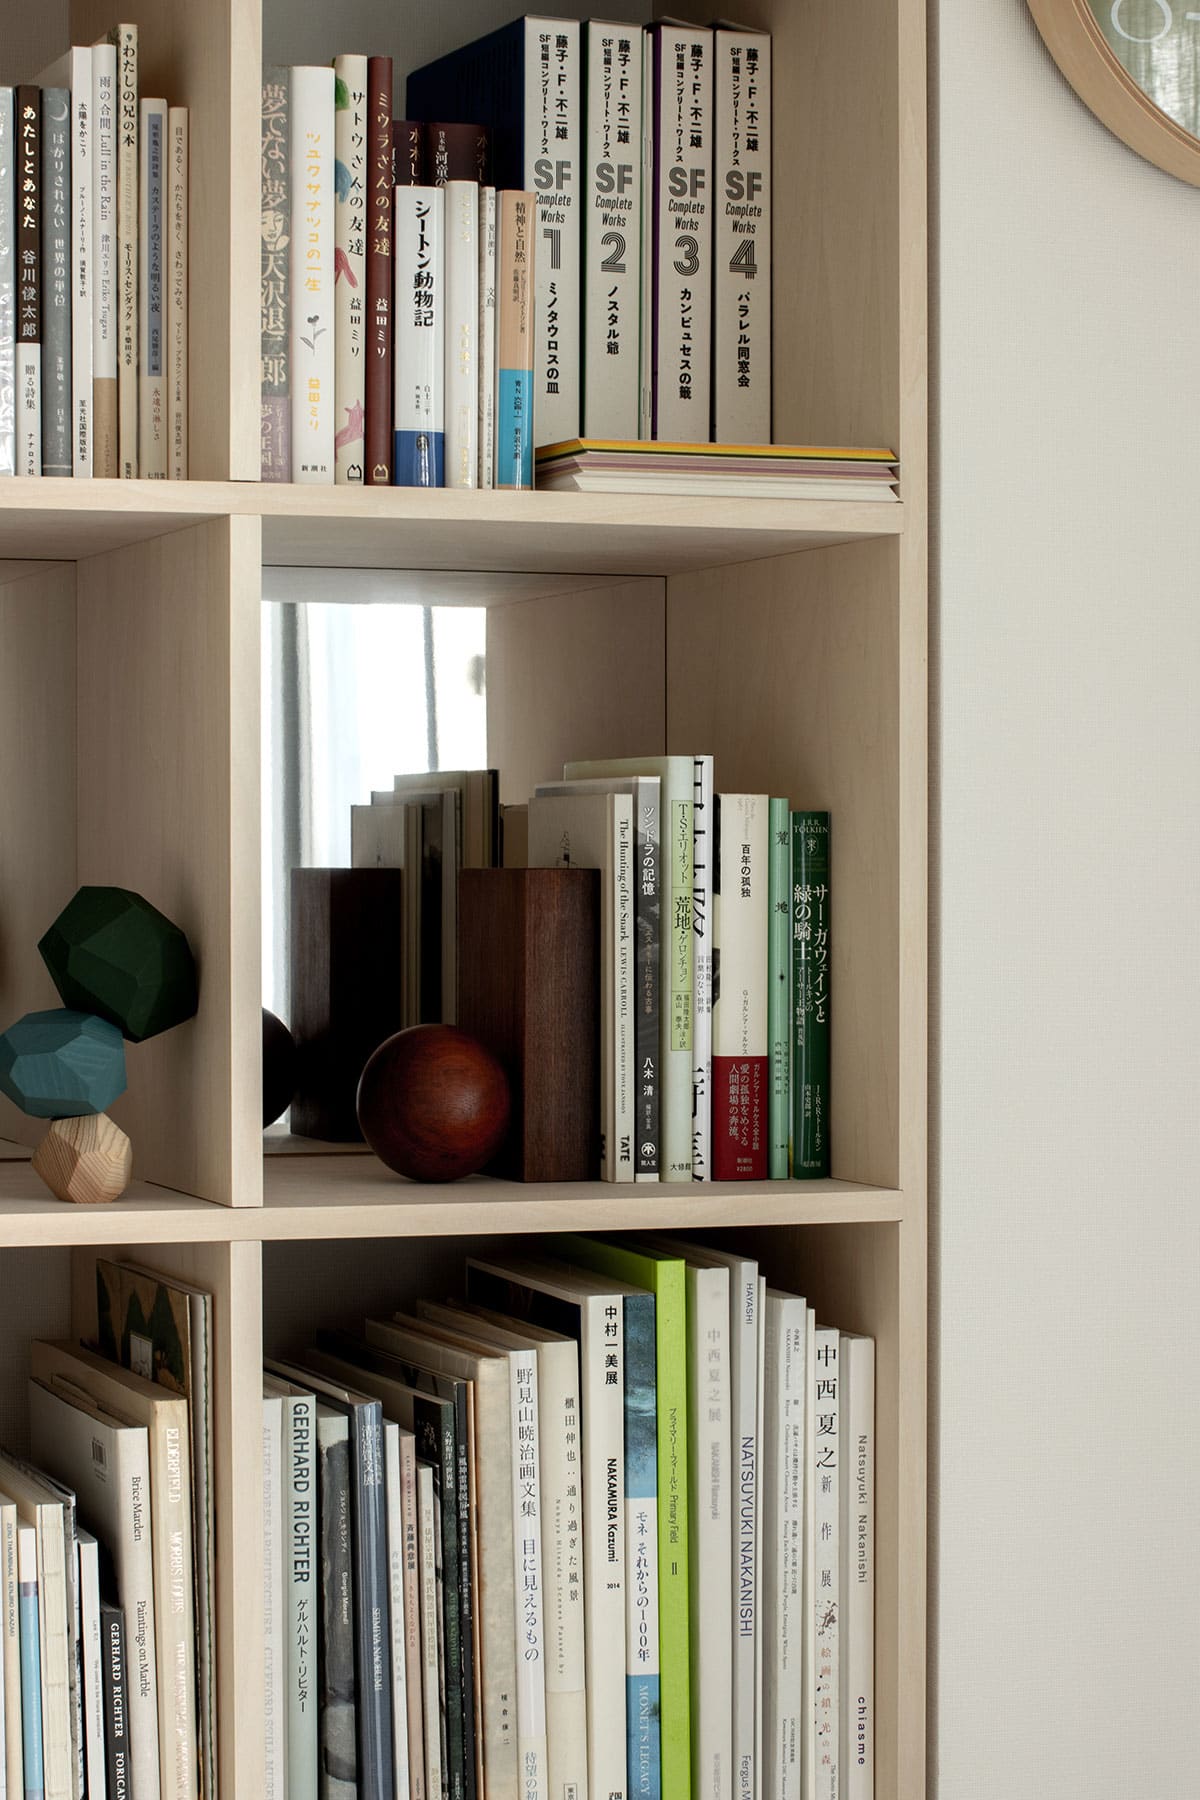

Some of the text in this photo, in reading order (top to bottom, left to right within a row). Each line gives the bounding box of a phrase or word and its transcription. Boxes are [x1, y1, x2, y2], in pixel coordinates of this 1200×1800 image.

[122, 45, 137, 147] わたしの兄の本
[539, 34, 551, 155] SF短編コンプリート・ワークス
[555, 35, 568, 140] 藤子・F・不二雄
[602, 38, 613, 158] SF短編コンプリート・ワークス
[617, 40, 631, 144] 藤子・F・不二雄
[674, 43, 687, 162] SF短編コンプリート・ワークス
[690, 44, 703, 149] 藤子・F・不二雄
[730, 47, 742, 166] SF短編コンプリート・ワークス
[746, 48, 759, 152] 藤子・F・不二雄
[78, 102, 87, 157] 太陽をかこう
[534, 158, 571, 190] SF
[535, 191, 571, 208] Complete
[595, 162, 633, 194] SF
[595, 194, 633, 212] Complete
[668, 166, 706, 198] SF
[725, 170, 763, 202] SF
[22, 105, 37, 338] あたしとあなた 谷川俊太郎
[100, 76, 111, 340] 雨の合間 Lull in the Rain 津川エリコ Eriko Tsugawa
[261, 84, 287, 386] 夢でない夢 天沢退二郎
[349, 91, 365, 358] サトウさんの友達 益田ミリ
[374, 92, 389, 359] ミウラさんの友達 益田ミリ
[514, 202, 525, 264] 精神と自然
[541, 209, 566, 224] Works
[602, 212, 627, 227] Works
[668, 198, 706, 216] Complete
[674, 216, 700, 231] Works
[725, 201, 763, 219] Complete
[732, 219, 757, 234] Works
[54, 239, 66, 307] 世界の単位
[151, 186, 160, 313] カステーラのような明るい夜
[413, 200, 434, 327] シートン動物記
[543, 228, 561, 270] 1
[600, 231, 627, 274] 2
[673, 234, 700, 277] 3
[729, 239, 758, 280] 4
[124, 243, 133, 321] モーリス・センダック
[306, 132, 321, 431] ツユクサナツコの一生 益田ミリ
[487, 287, 496, 307] 文鳥
[546, 282, 559, 394] ミノタウロスの皿
[607, 286, 619, 355] ノスタル爺
[679, 288, 692, 400] カンビュセスの籤
[737, 291, 750, 388] パラレル同窓会
[25, 364, 36, 410] 贈る詩集
[424, 385, 432, 416] 白土三平
[27, 433, 36, 476] ナナロク社
[301, 464, 327, 472] 新潮社
[619, 819, 629, 838] The
[641, 807, 655, 896] ツンドラの記憶
[677, 803, 690, 884] T・S・エリオット
[617, 841, 629, 882] Hunting
[619, 883, 629, 893] of
[740, 843, 751, 898] 百年の孤独
[619, 893, 629, 911] the
[619, 912, 629, 941] Snark
[793, 883, 812, 961] 緑の騎士
[674, 896, 691, 983] 荒地・ゲロンチョン
[813, 883, 829, 1023] サー・ガウェインと
[696, 956, 704, 1015] 言葉のない世界
[805, 966, 814, 1012] トールキンの
[729, 1063, 740, 1141] 人間劇場の奔流。
[740, 1063, 750, 1147] 愛の孤独をめぐる
[620, 1135, 630, 1162] TATE
[604, 1305, 619, 1385] 中村一美展
[707, 1327, 722, 1423] 中西夏之展
[167, 1428, 181, 1503] ELDERFIELD
[263, 1426, 272, 1474] ALLIED
[361, 1424, 375, 1487] 清宮質文展
[740, 1283, 755, 1637] HAYASHI NATSUYUKI NAKANISHI
[815, 1344, 837, 1588] 中西夏之 新作展
[132, 1476, 144, 1541] Brice Marden
[293, 1402, 310, 1583] GERHARD RICHTER
[516, 1367, 539, 1661] 野見山暁治画文集 目に見えるもの
[607, 1458, 619, 1563] NAKAMURA Kazumi
[636, 1511, 649, 1536] モネ
[669, 1494, 679, 1524] Primary
[857, 1435, 868, 1583] Natsuyuki Nakanishi
[169, 1531, 183, 1576] MORRIS
[670, 1525, 679, 1544] Field
[171, 1577, 184, 1613] LOUIS
[606, 1582, 620, 1590] 2014
[110, 1623, 121, 1681] GERHARD
[135, 1600, 151, 1697] Paintings on Marble
[297, 1599, 309, 1713] ゲルハルト・リヒター
[372, 1607, 383, 1691] SEIMIYA NAOBUMI
[113, 1686, 123, 1738] RICHTER
[857, 1696, 868, 1765] chiasme
[639, 1744, 650, 1797] LEGACY
[740, 1755, 751, 1788] Fergus
